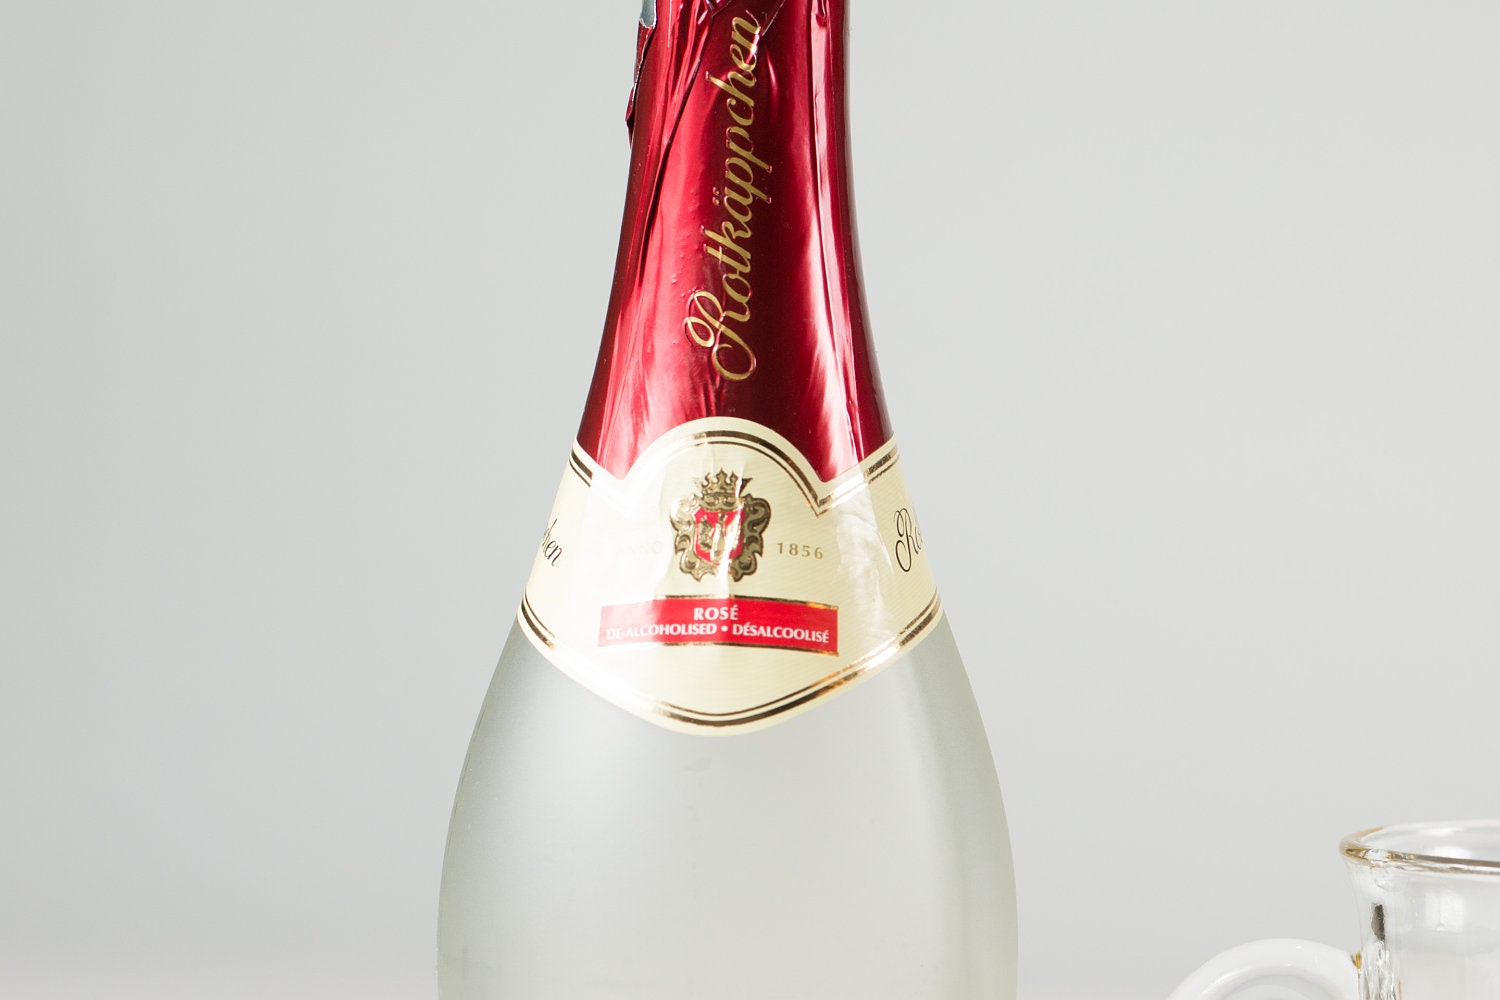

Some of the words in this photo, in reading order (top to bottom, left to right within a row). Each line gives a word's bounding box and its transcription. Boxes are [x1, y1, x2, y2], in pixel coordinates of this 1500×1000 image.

[684, 10, 772, 381] Rotkäppchen
[776, 541, 824, 560] 1856
[693, 605, 739, 621] ROSÉ
[606, 623, 717, 640] DE-ALCOHOLISED
[732, 622, 830, 644] DÉSALCOOLISÉ
